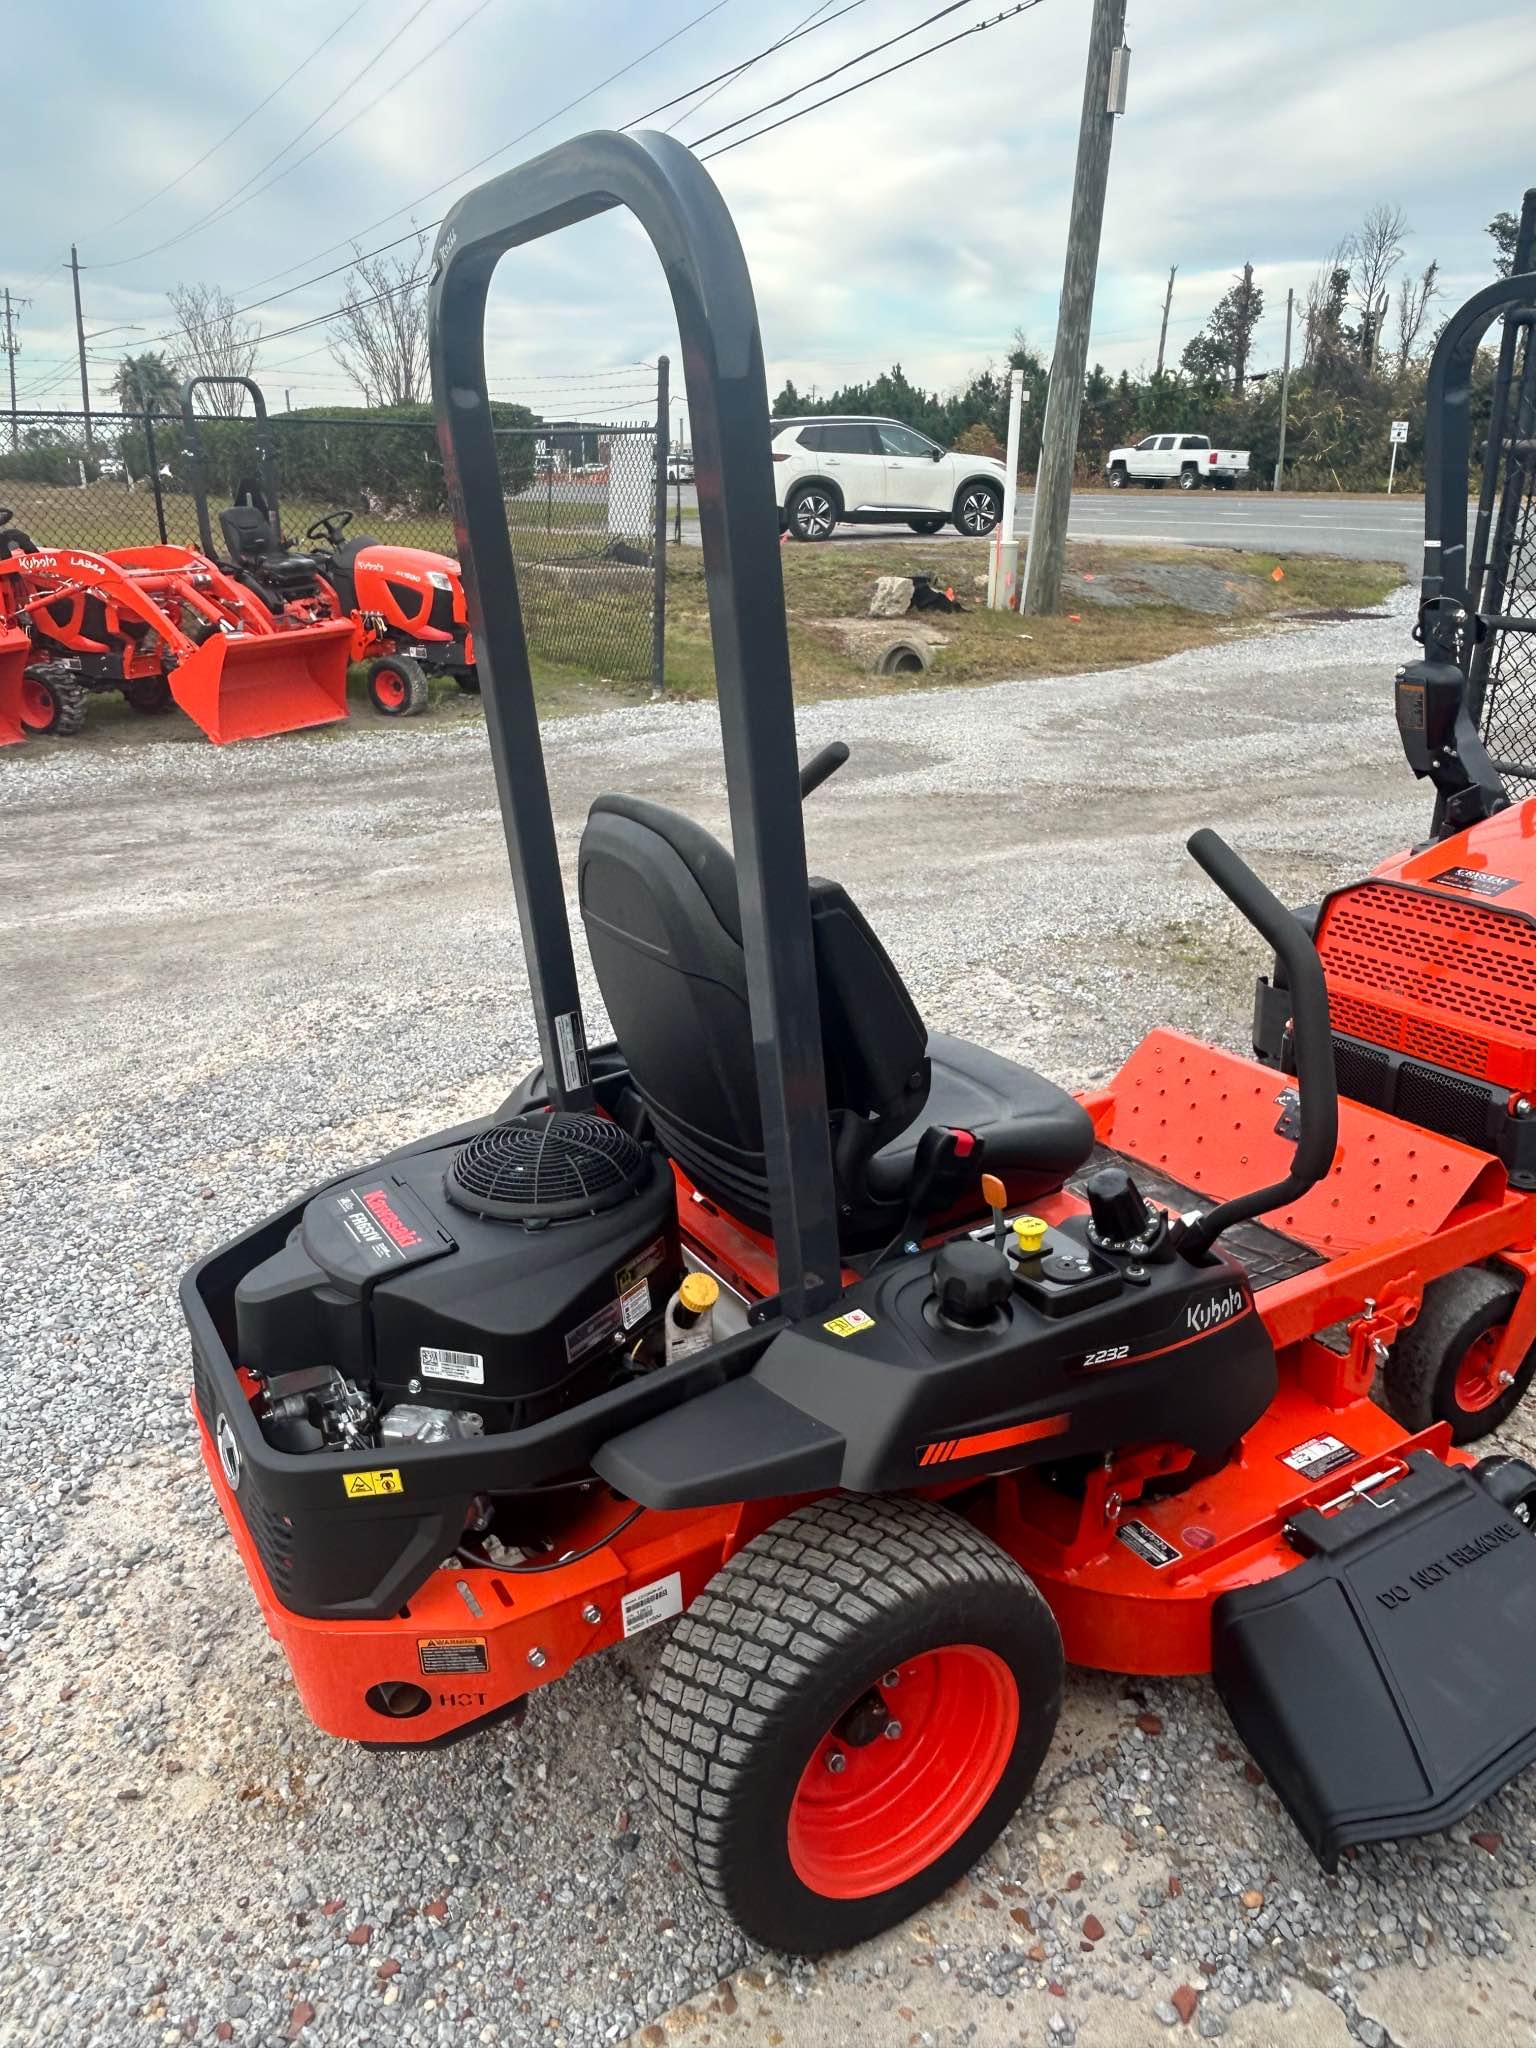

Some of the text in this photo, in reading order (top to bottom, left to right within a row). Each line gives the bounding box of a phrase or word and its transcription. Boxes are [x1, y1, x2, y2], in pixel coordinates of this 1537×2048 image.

[18, 555, 57, 570] Kubota
[363, 1190, 422, 1247] Kawasaki
[1187, 1287, 1243, 1332] Kubota
[1083, 1345, 1130, 1367] Z232
[1375, 1523, 1521, 1610] DO NOT REMOVE
[439, 1692, 487, 1707] HOT
